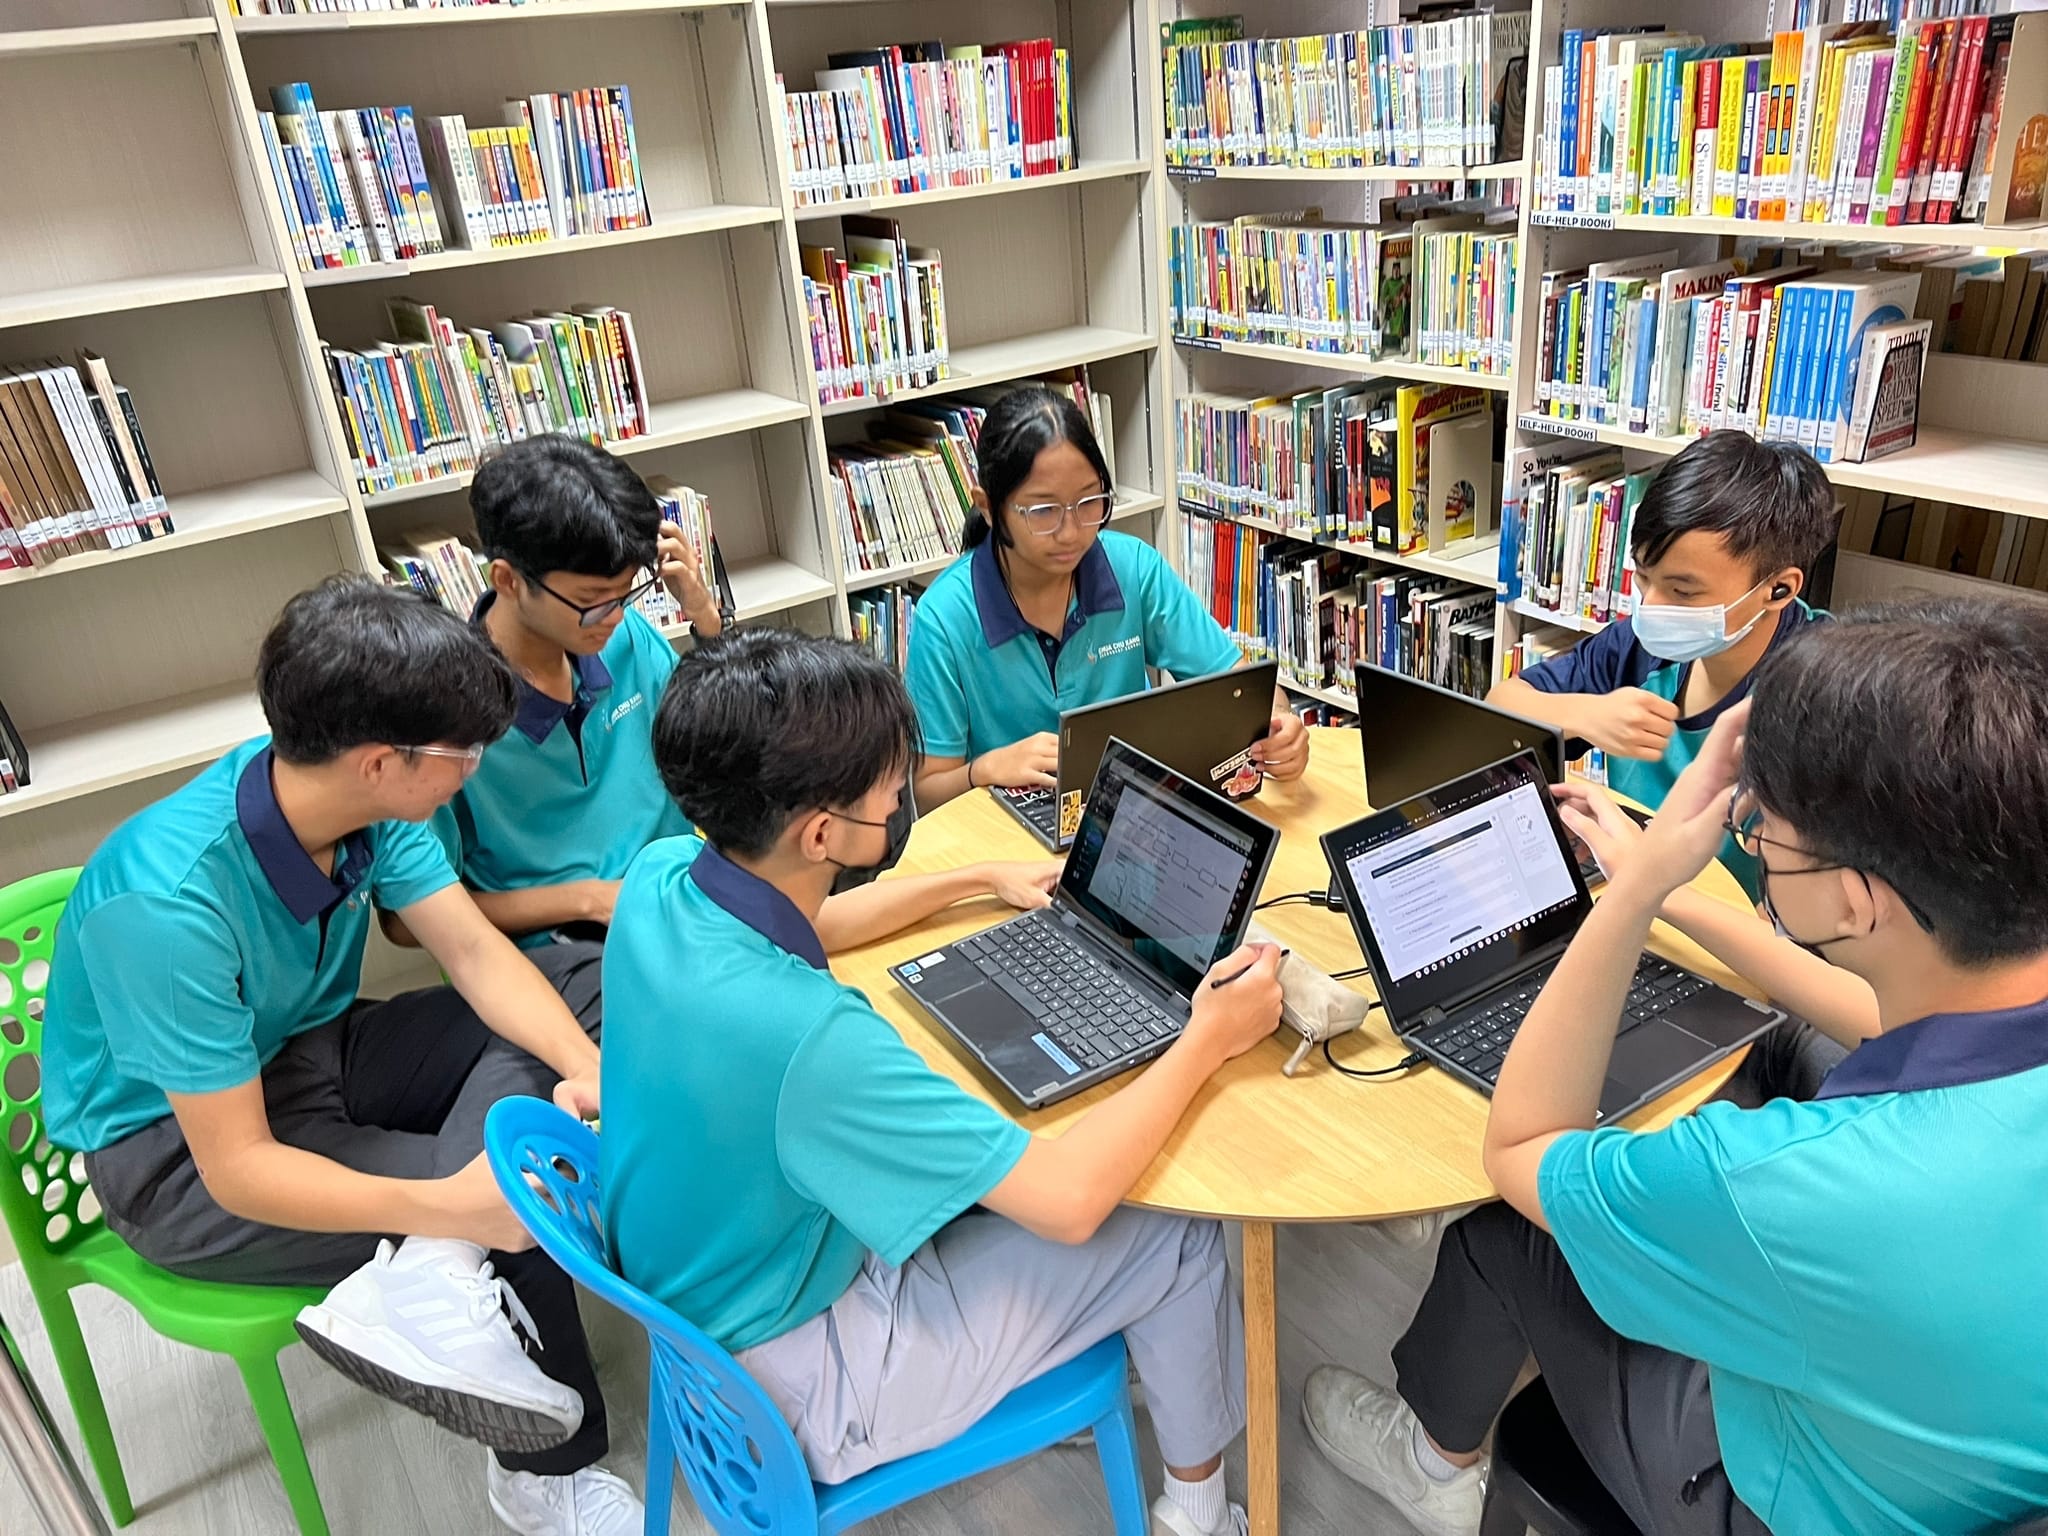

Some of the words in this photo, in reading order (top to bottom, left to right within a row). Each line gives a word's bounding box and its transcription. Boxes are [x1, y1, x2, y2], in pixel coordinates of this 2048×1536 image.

[1898, 39, 1912, 71] TONY
[1891, 73, 1906, 115] BUZAN
[1532, 213, 1578, 227] SELF-HELP
[1580, 217, 1612, 229] BOOKS
[1674, 270, 1737, 299] MAKING
[1880, 376, 1917, 402] READIN
[1520, 418, 1563, 435] SELF-HELP
[1564, 427, 1595, 441] BOOKS
[1523, 461, 1534, 474] So
